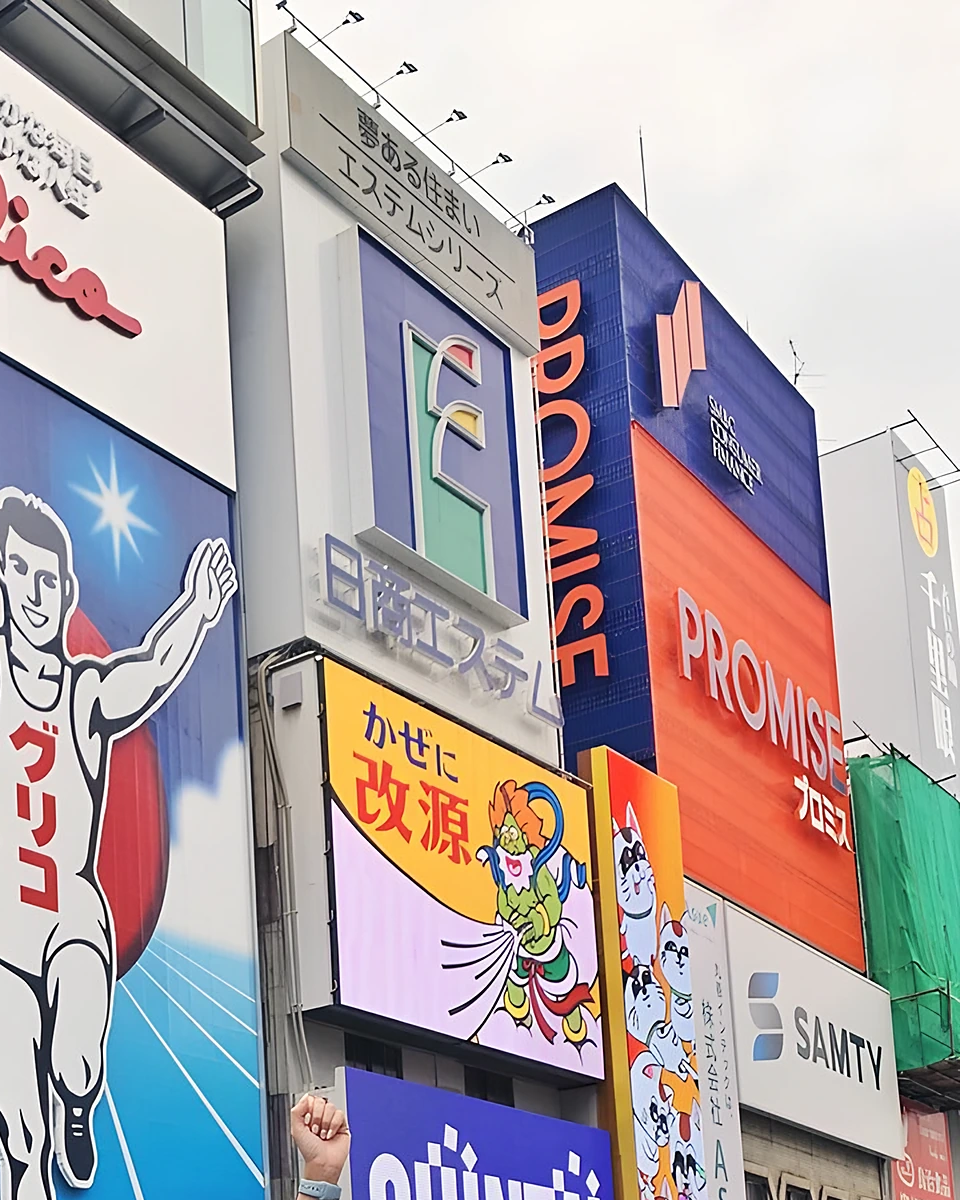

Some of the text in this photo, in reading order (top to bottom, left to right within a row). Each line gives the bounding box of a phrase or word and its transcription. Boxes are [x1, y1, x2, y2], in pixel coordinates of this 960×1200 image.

[337, 145, 503, 310] エステムシリーズ
[362, 701, 459, 784] かぜに
[676, 587, 849, 797] PROMISE
[8, 720, 59, 913] グリコ
[352, 751, 473, 866] 改源
[793, 775, 856, 855] プロミス
[793, 1005, 884, 1092] SAMTY
